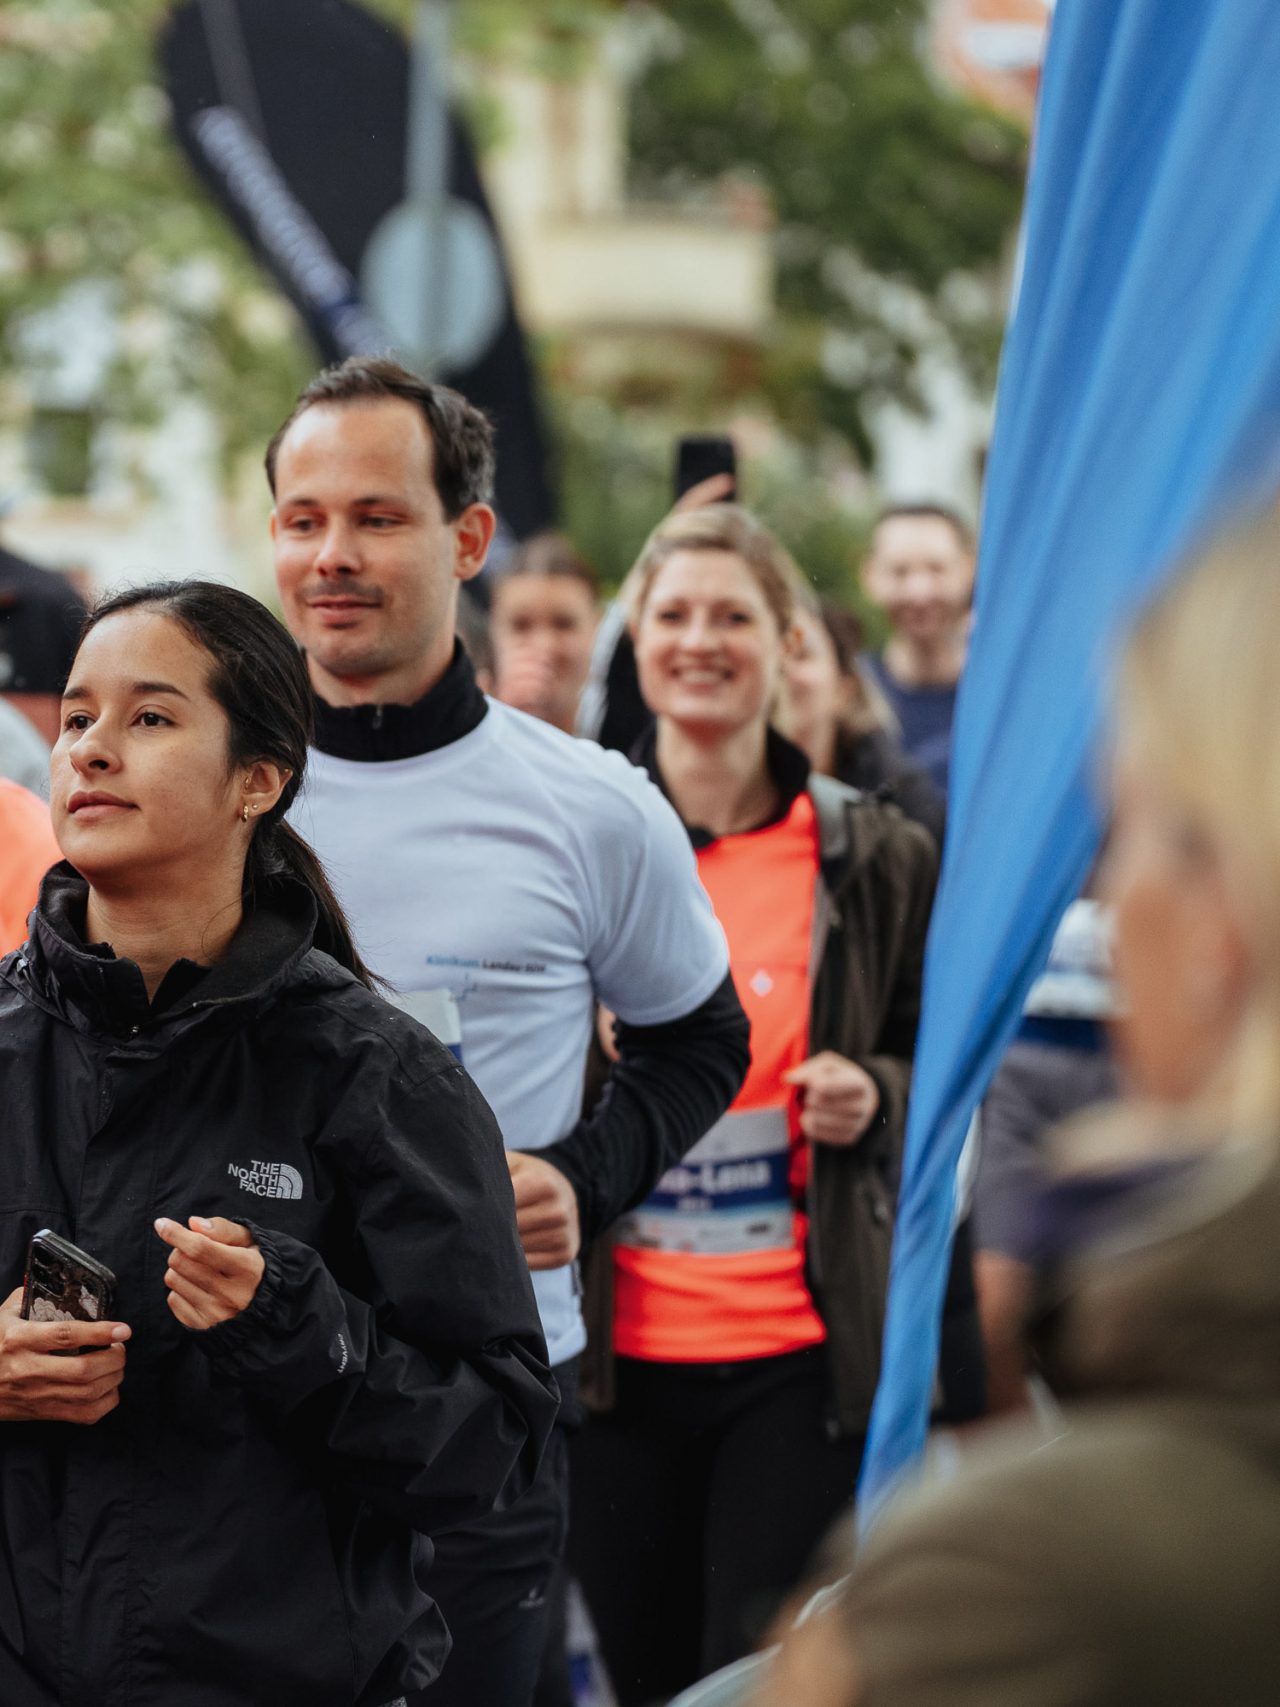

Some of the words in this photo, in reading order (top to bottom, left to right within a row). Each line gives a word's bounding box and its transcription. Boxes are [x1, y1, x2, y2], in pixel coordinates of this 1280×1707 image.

[227, 1163, 279, 1186] NORTH
[250, 1160, 280, 1175] THE
[239, 1179, 277, 1198] FACE
